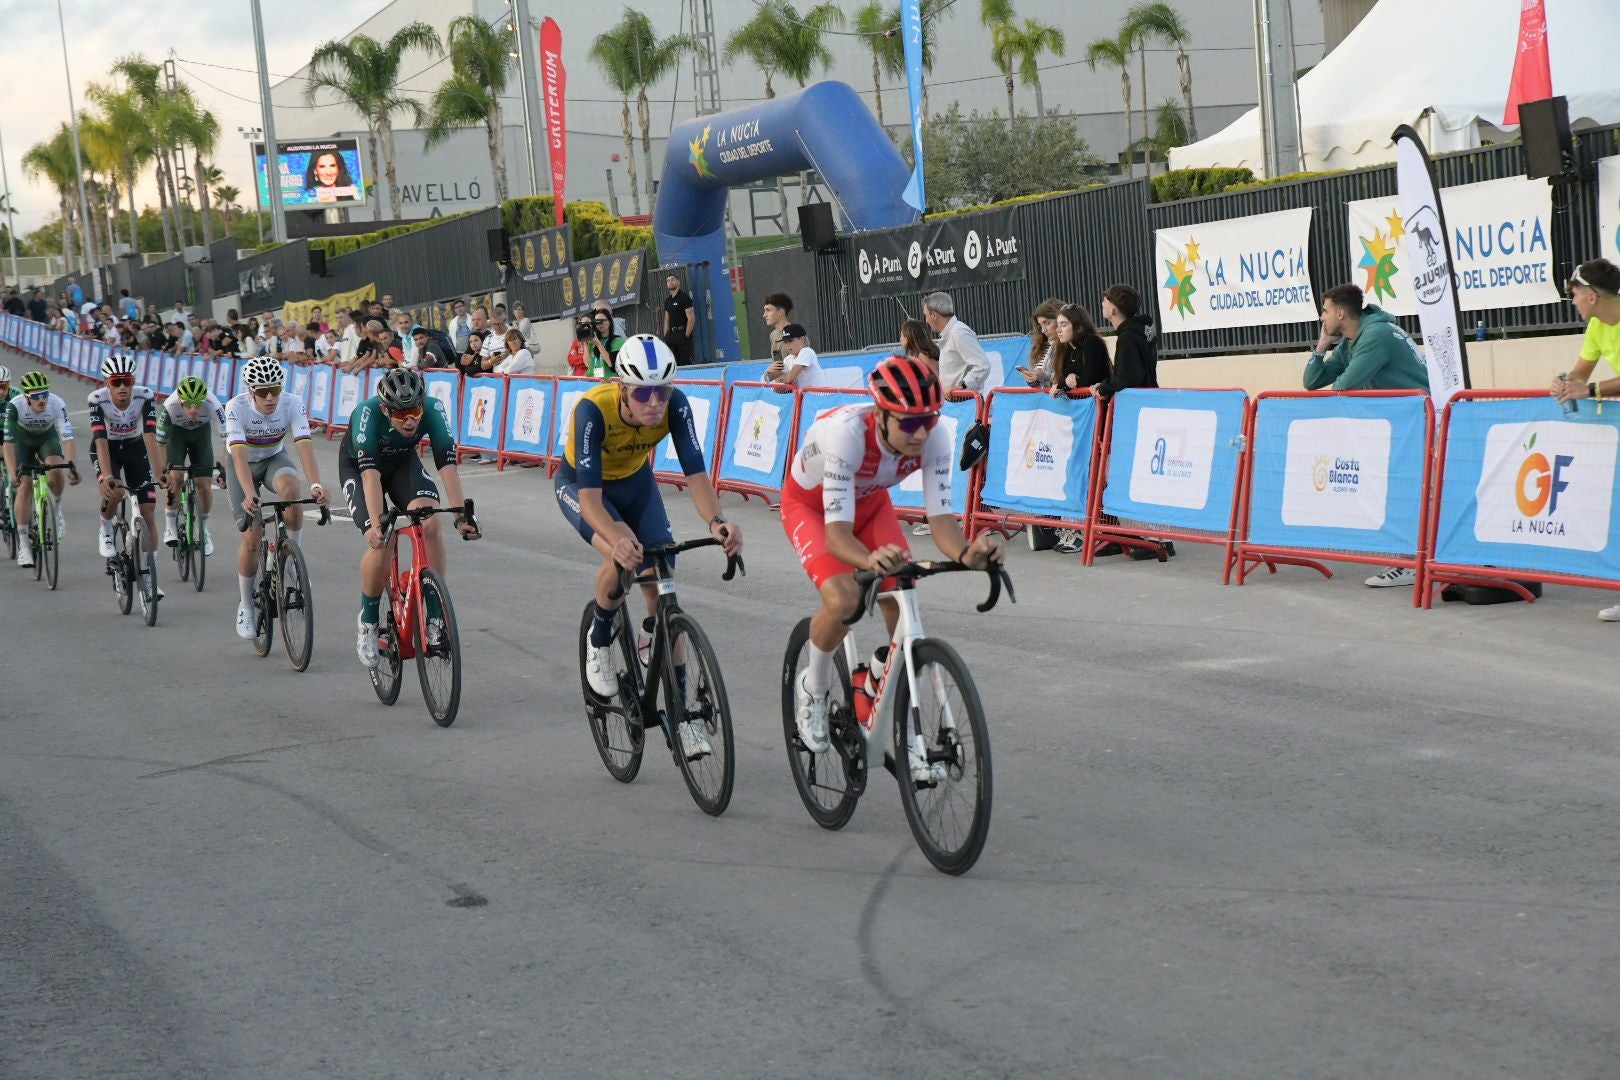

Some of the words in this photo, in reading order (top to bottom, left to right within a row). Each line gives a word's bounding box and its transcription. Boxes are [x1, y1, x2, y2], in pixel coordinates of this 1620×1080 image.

[717, 129, 727, 147] LA
[747, 139, 774, 157] DEPORTE
[934, 246, 956, 265] Punt
[995, 235, 1018, 256] Punt
[1205, 256, 1227, 286] LA
[1463, 269, 1486, 290] DEL
[1489, 262, 1547, 288] DEPORTE
[1209, 292, 1245, 310] CIUDAD
[1245, 290, 1263, 308] DEL
[1265, 285, 1311, 306] DEPORTE
[583, 421, 593, 454] CORTIZO
[1335, 457, 1360, 471] Costa
[1329, 470, 1359, 485] Blanca
[1515, 452, 1575, 517] GF
[1512, 519, 1523, 533] LA
